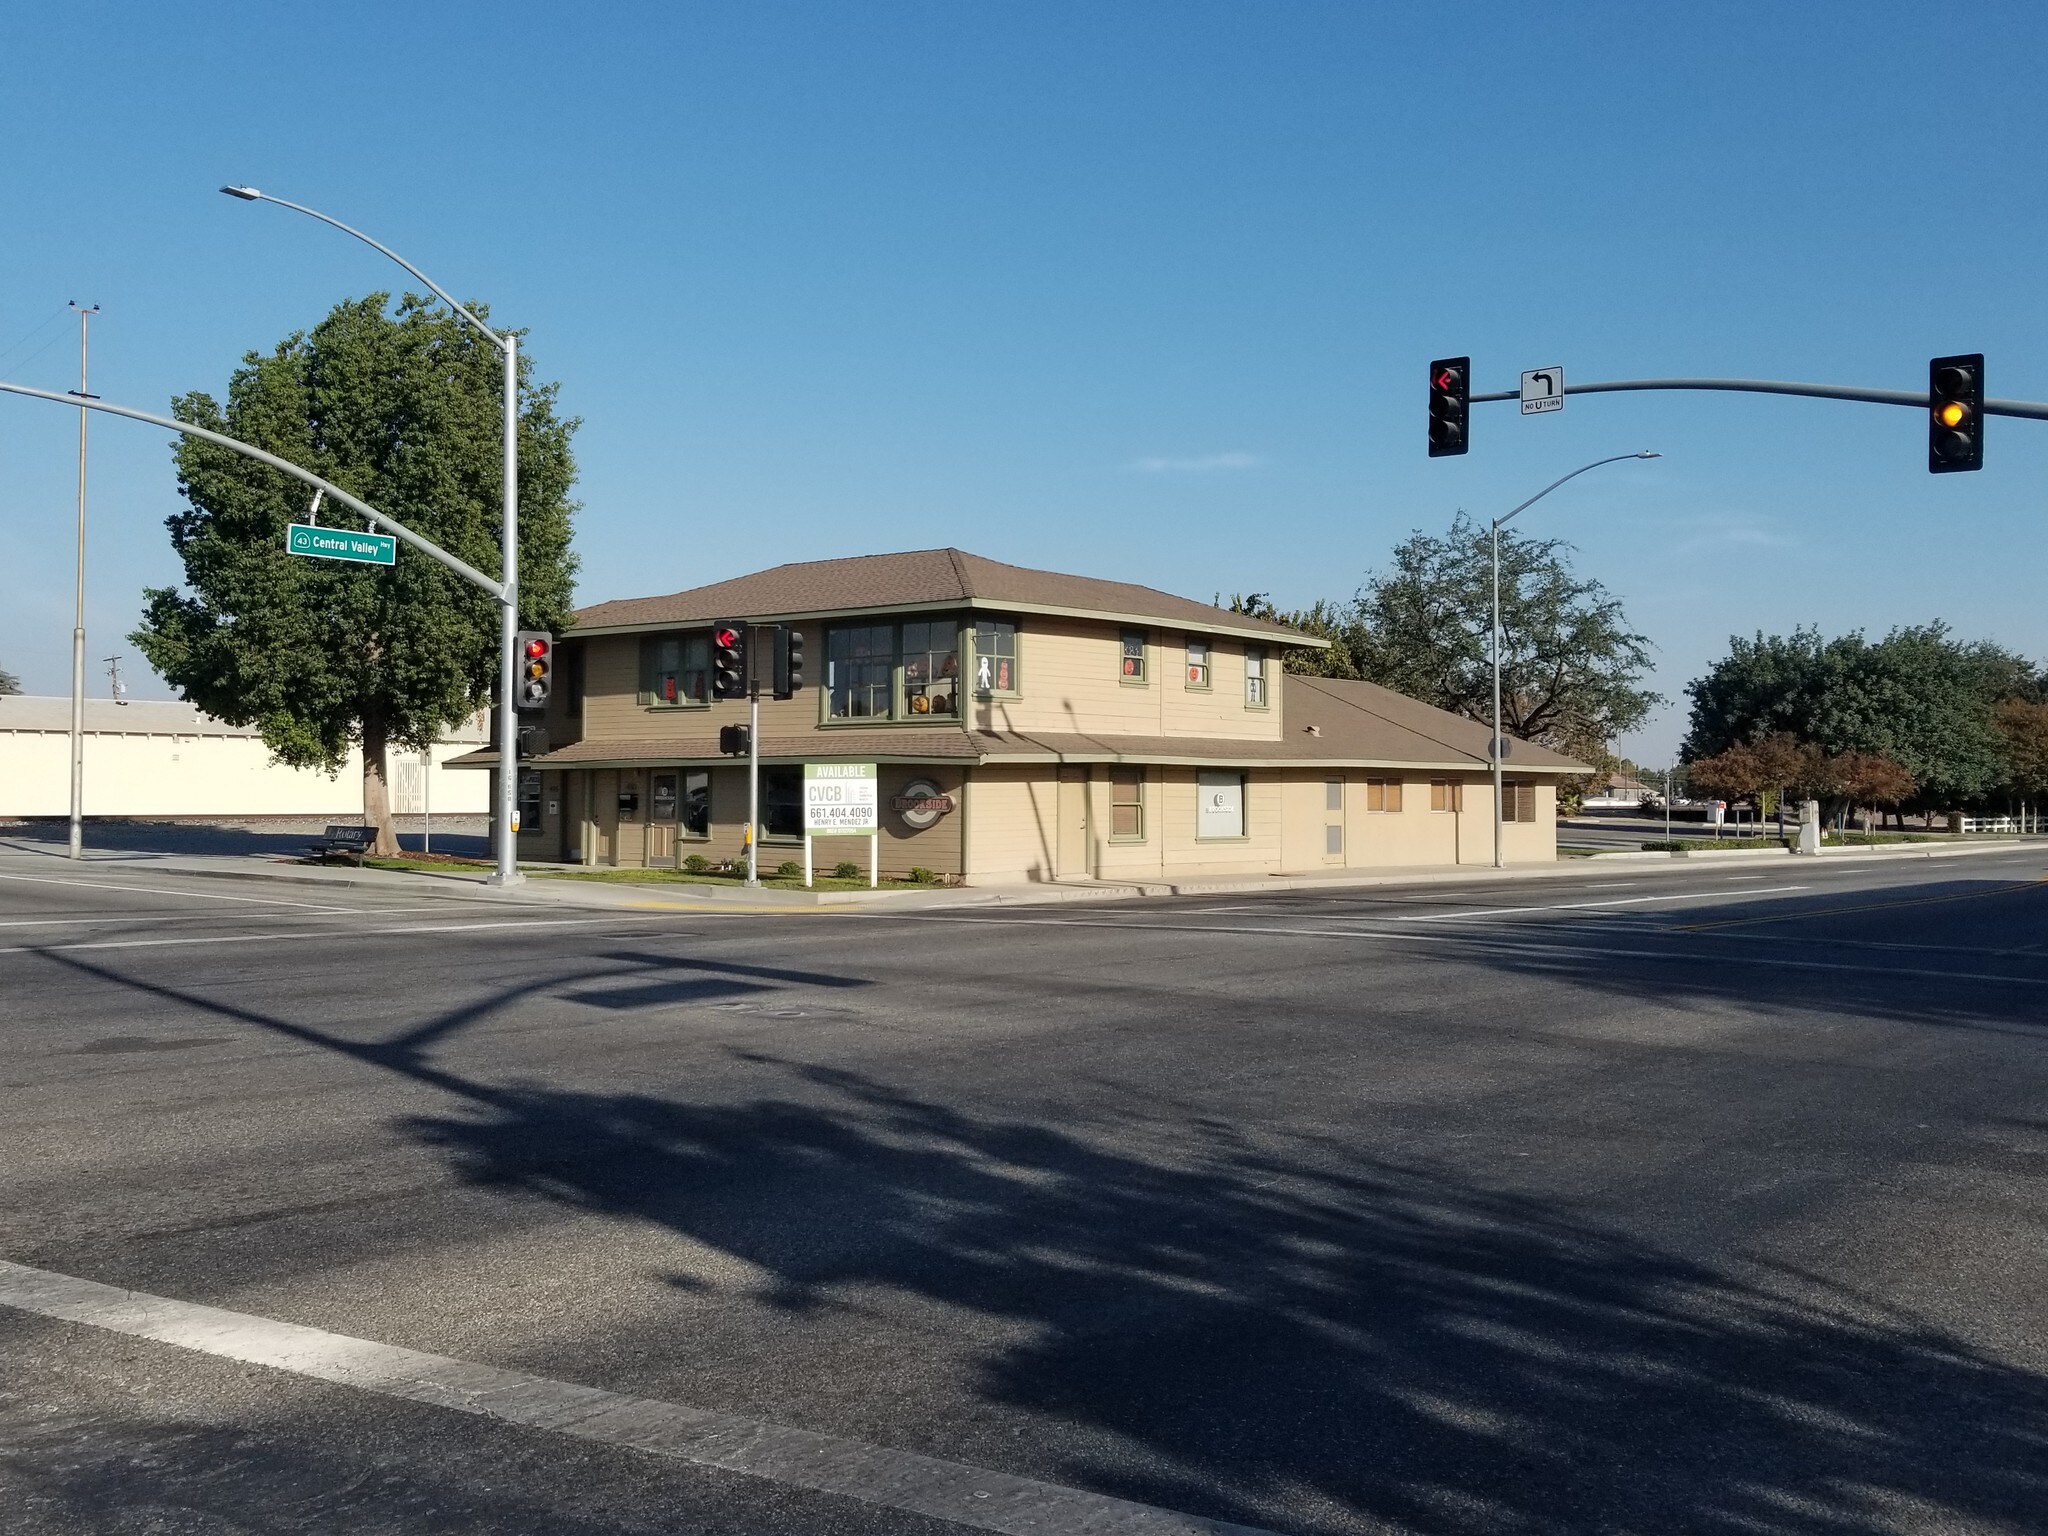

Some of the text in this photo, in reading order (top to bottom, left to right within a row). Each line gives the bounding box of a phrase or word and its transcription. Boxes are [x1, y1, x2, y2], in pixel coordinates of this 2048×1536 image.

[1525, 399, 1560, 411] NO U TURN
[297, 536, 391, 557] 43 Central Valley Hwy
[816, 765, 866, 778] AVAILABLE
[809, 785, 842, 802] CVCB
[810, 807, 873, 819] 661.404.4090
[839, 818, 861, 826] MENDEZ
